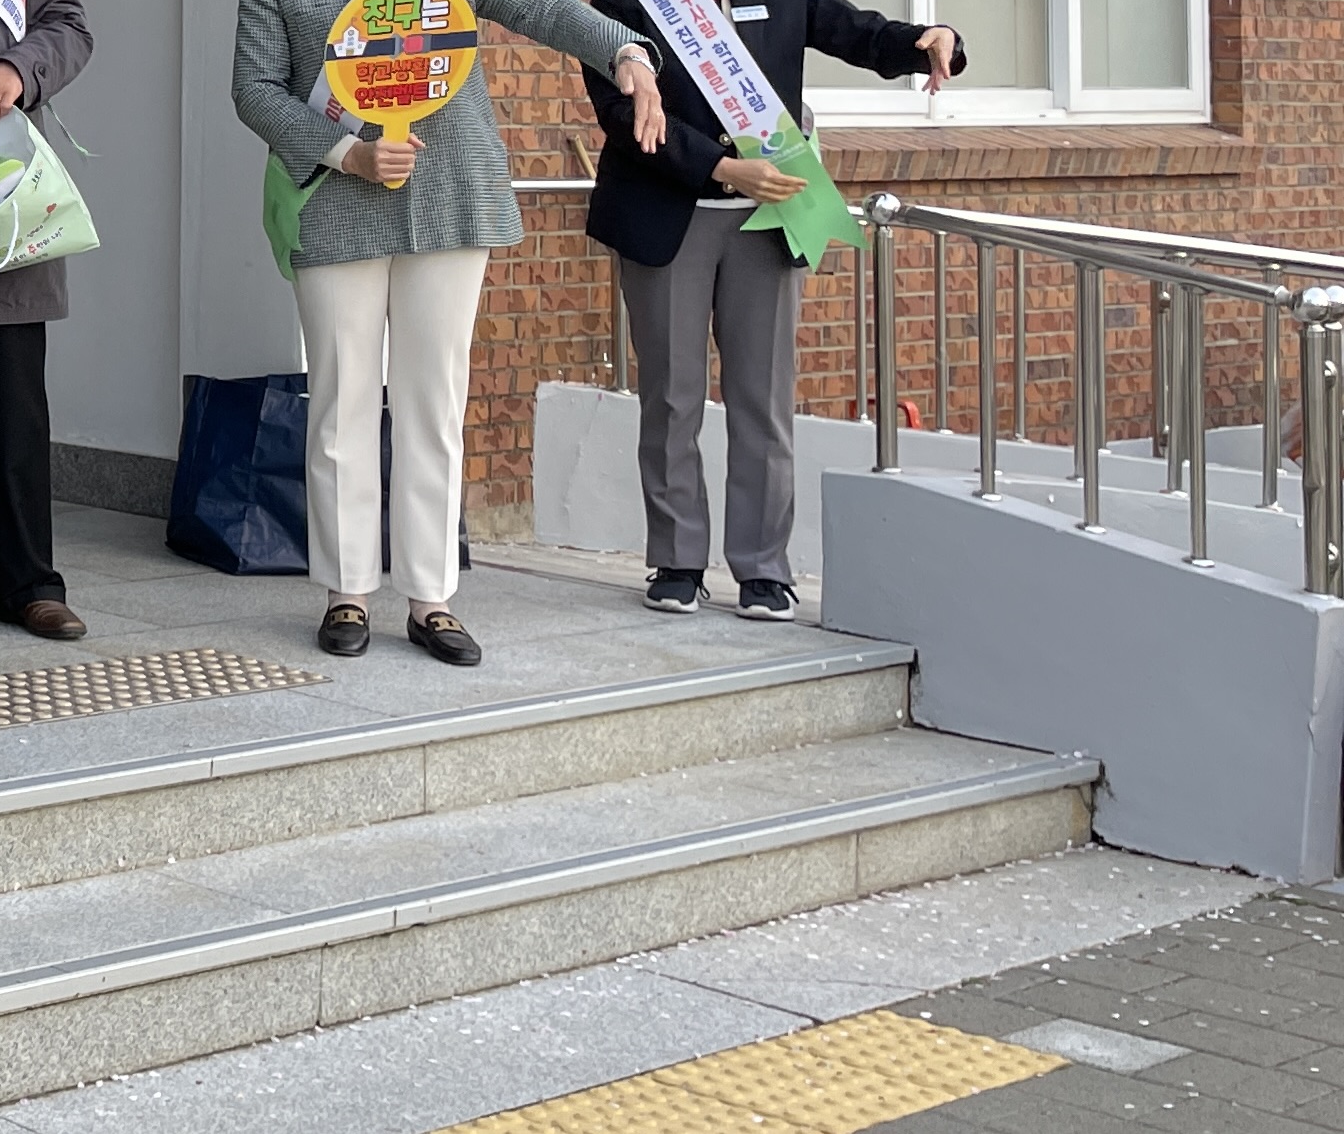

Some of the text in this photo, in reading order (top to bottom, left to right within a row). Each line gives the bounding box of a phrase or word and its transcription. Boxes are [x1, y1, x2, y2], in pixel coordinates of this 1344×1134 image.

[355, 56, 450, 84] 학교생활의
[675, 26, 703, 59] 친구
[722, 95, 753, 132] 학교
[354, 80, 449, 110] 안전벨트다
